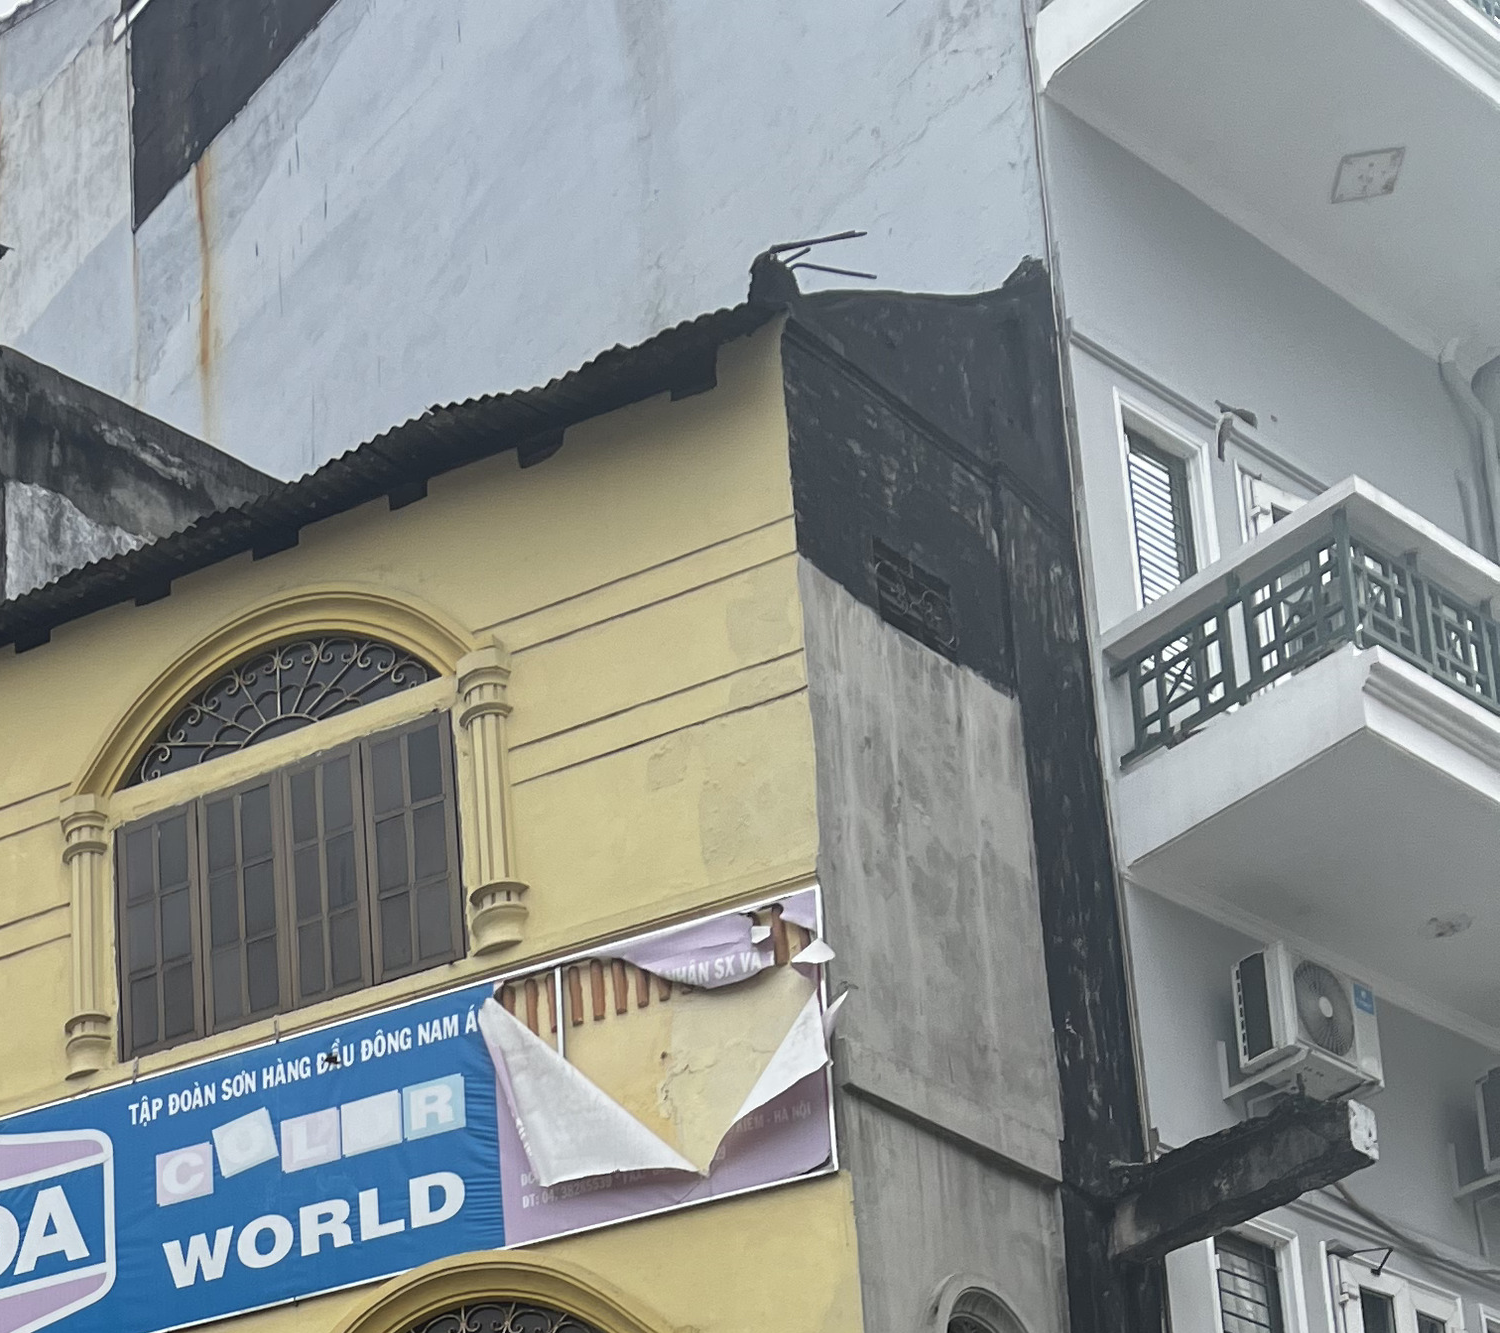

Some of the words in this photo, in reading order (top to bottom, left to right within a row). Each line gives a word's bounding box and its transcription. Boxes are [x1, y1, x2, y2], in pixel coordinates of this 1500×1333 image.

[129, 1094, 162, 1127] TẬP
[168, 1081, 216, 1114] ĐOÀN
[221, 1070, 256, 1102] SƠN
[262, 1056, 311, 1089] HÀNG
[361, 1028, 412, 1063] ĐÔNG
[418, 1016, 459, 1046] NAM
[161, 1169, 466, 1290] WORLD
